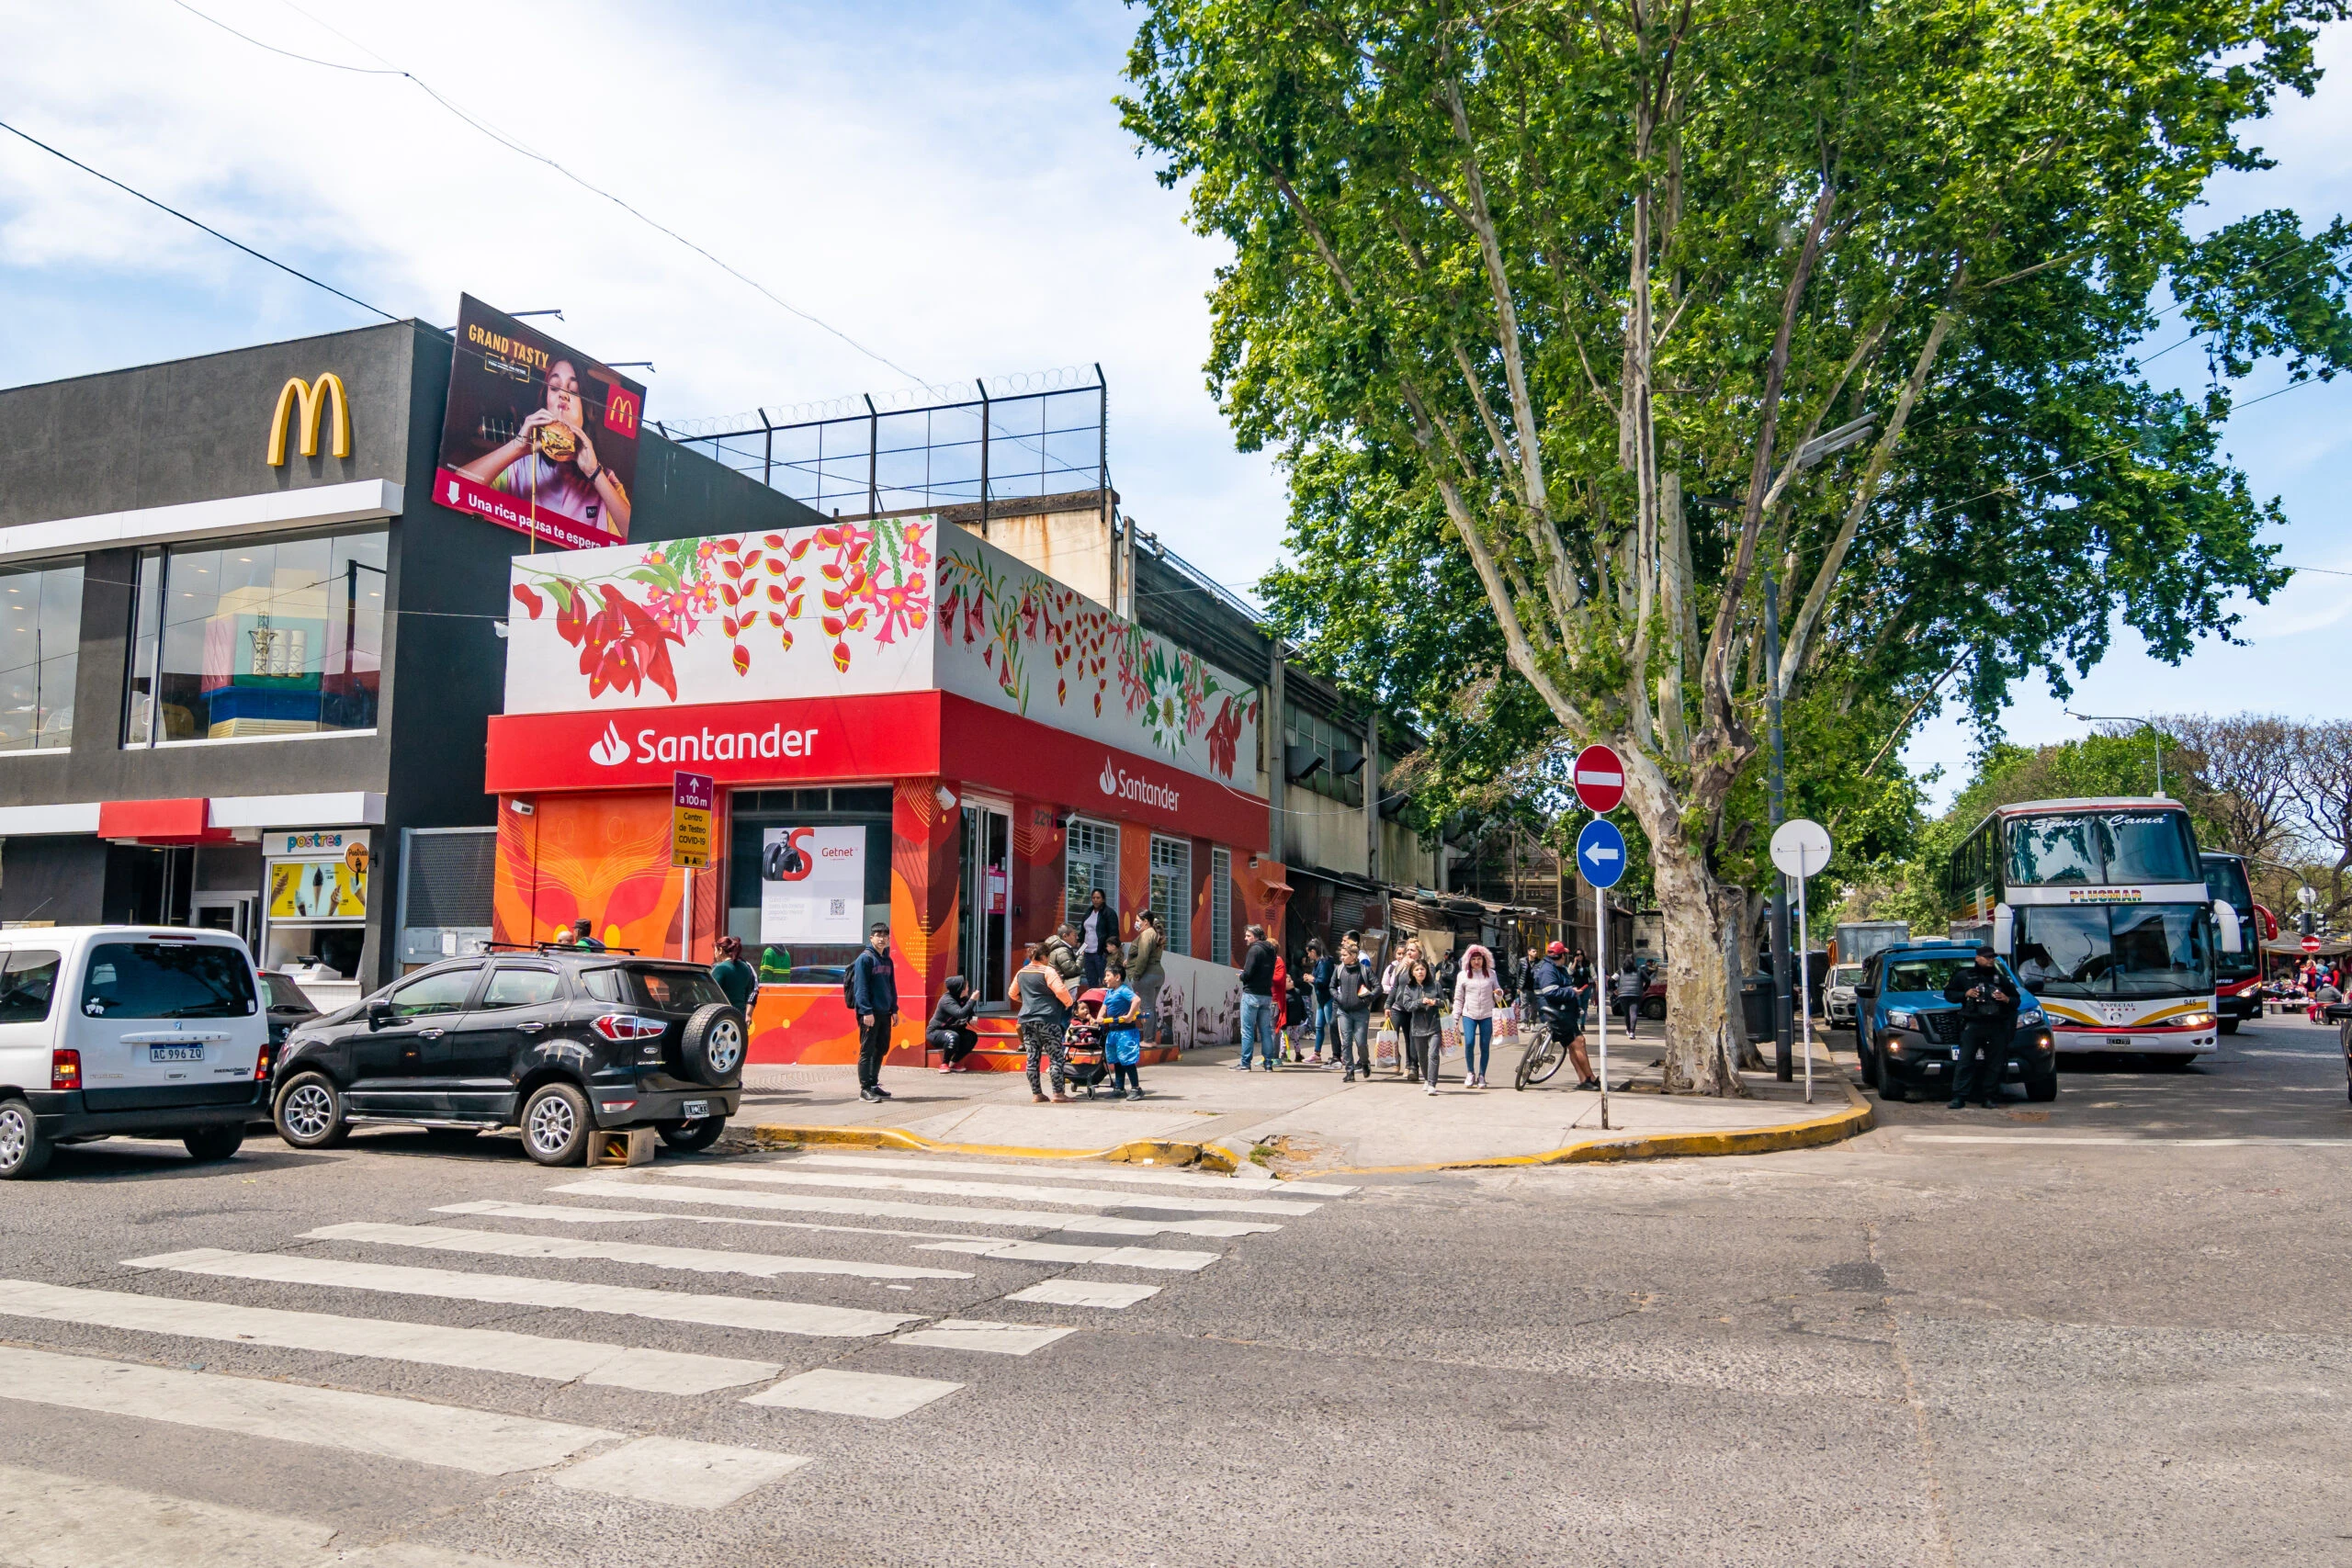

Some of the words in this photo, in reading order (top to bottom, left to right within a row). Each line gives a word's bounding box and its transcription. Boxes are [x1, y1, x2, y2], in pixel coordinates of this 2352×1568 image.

[469, 324, 509, 354] GRAND
[513, 341, 549, 368] TASTY
[468, 493, 492, 513] Una
[494, 504, 516, 522] rica
[519, 513, 551, 535] pausa
[554, 525, 565, 538] te
[637, 723, 818, 764] Santander
[1118, 769, 1180, 812] Santander
[680, 795, 684, 804] a
[685, 795, 699, 806] 100
[700, 798, 707, 807] m
[684, 812, 703, 822] Centro
[2030, 818, 2083, 830] Semi
[2108, 814, 2167, 827] Cama
[679, 824, 686, 832] de
[688, 824, 707, 834] Testeo
[288, 832, 343, 853] postres
[678, 835, 706, 846] COVID-19
[821, 847, 854, 857] Getnet
[2069, 889, 2143, 903] PLUSMAR
[2183, 998, 2198, 1007] 945
[153, 1049, 165, 1059] AC
[168, 1049, 187, 1059] 996
[189, 1048, 202, 1058] ZQ
